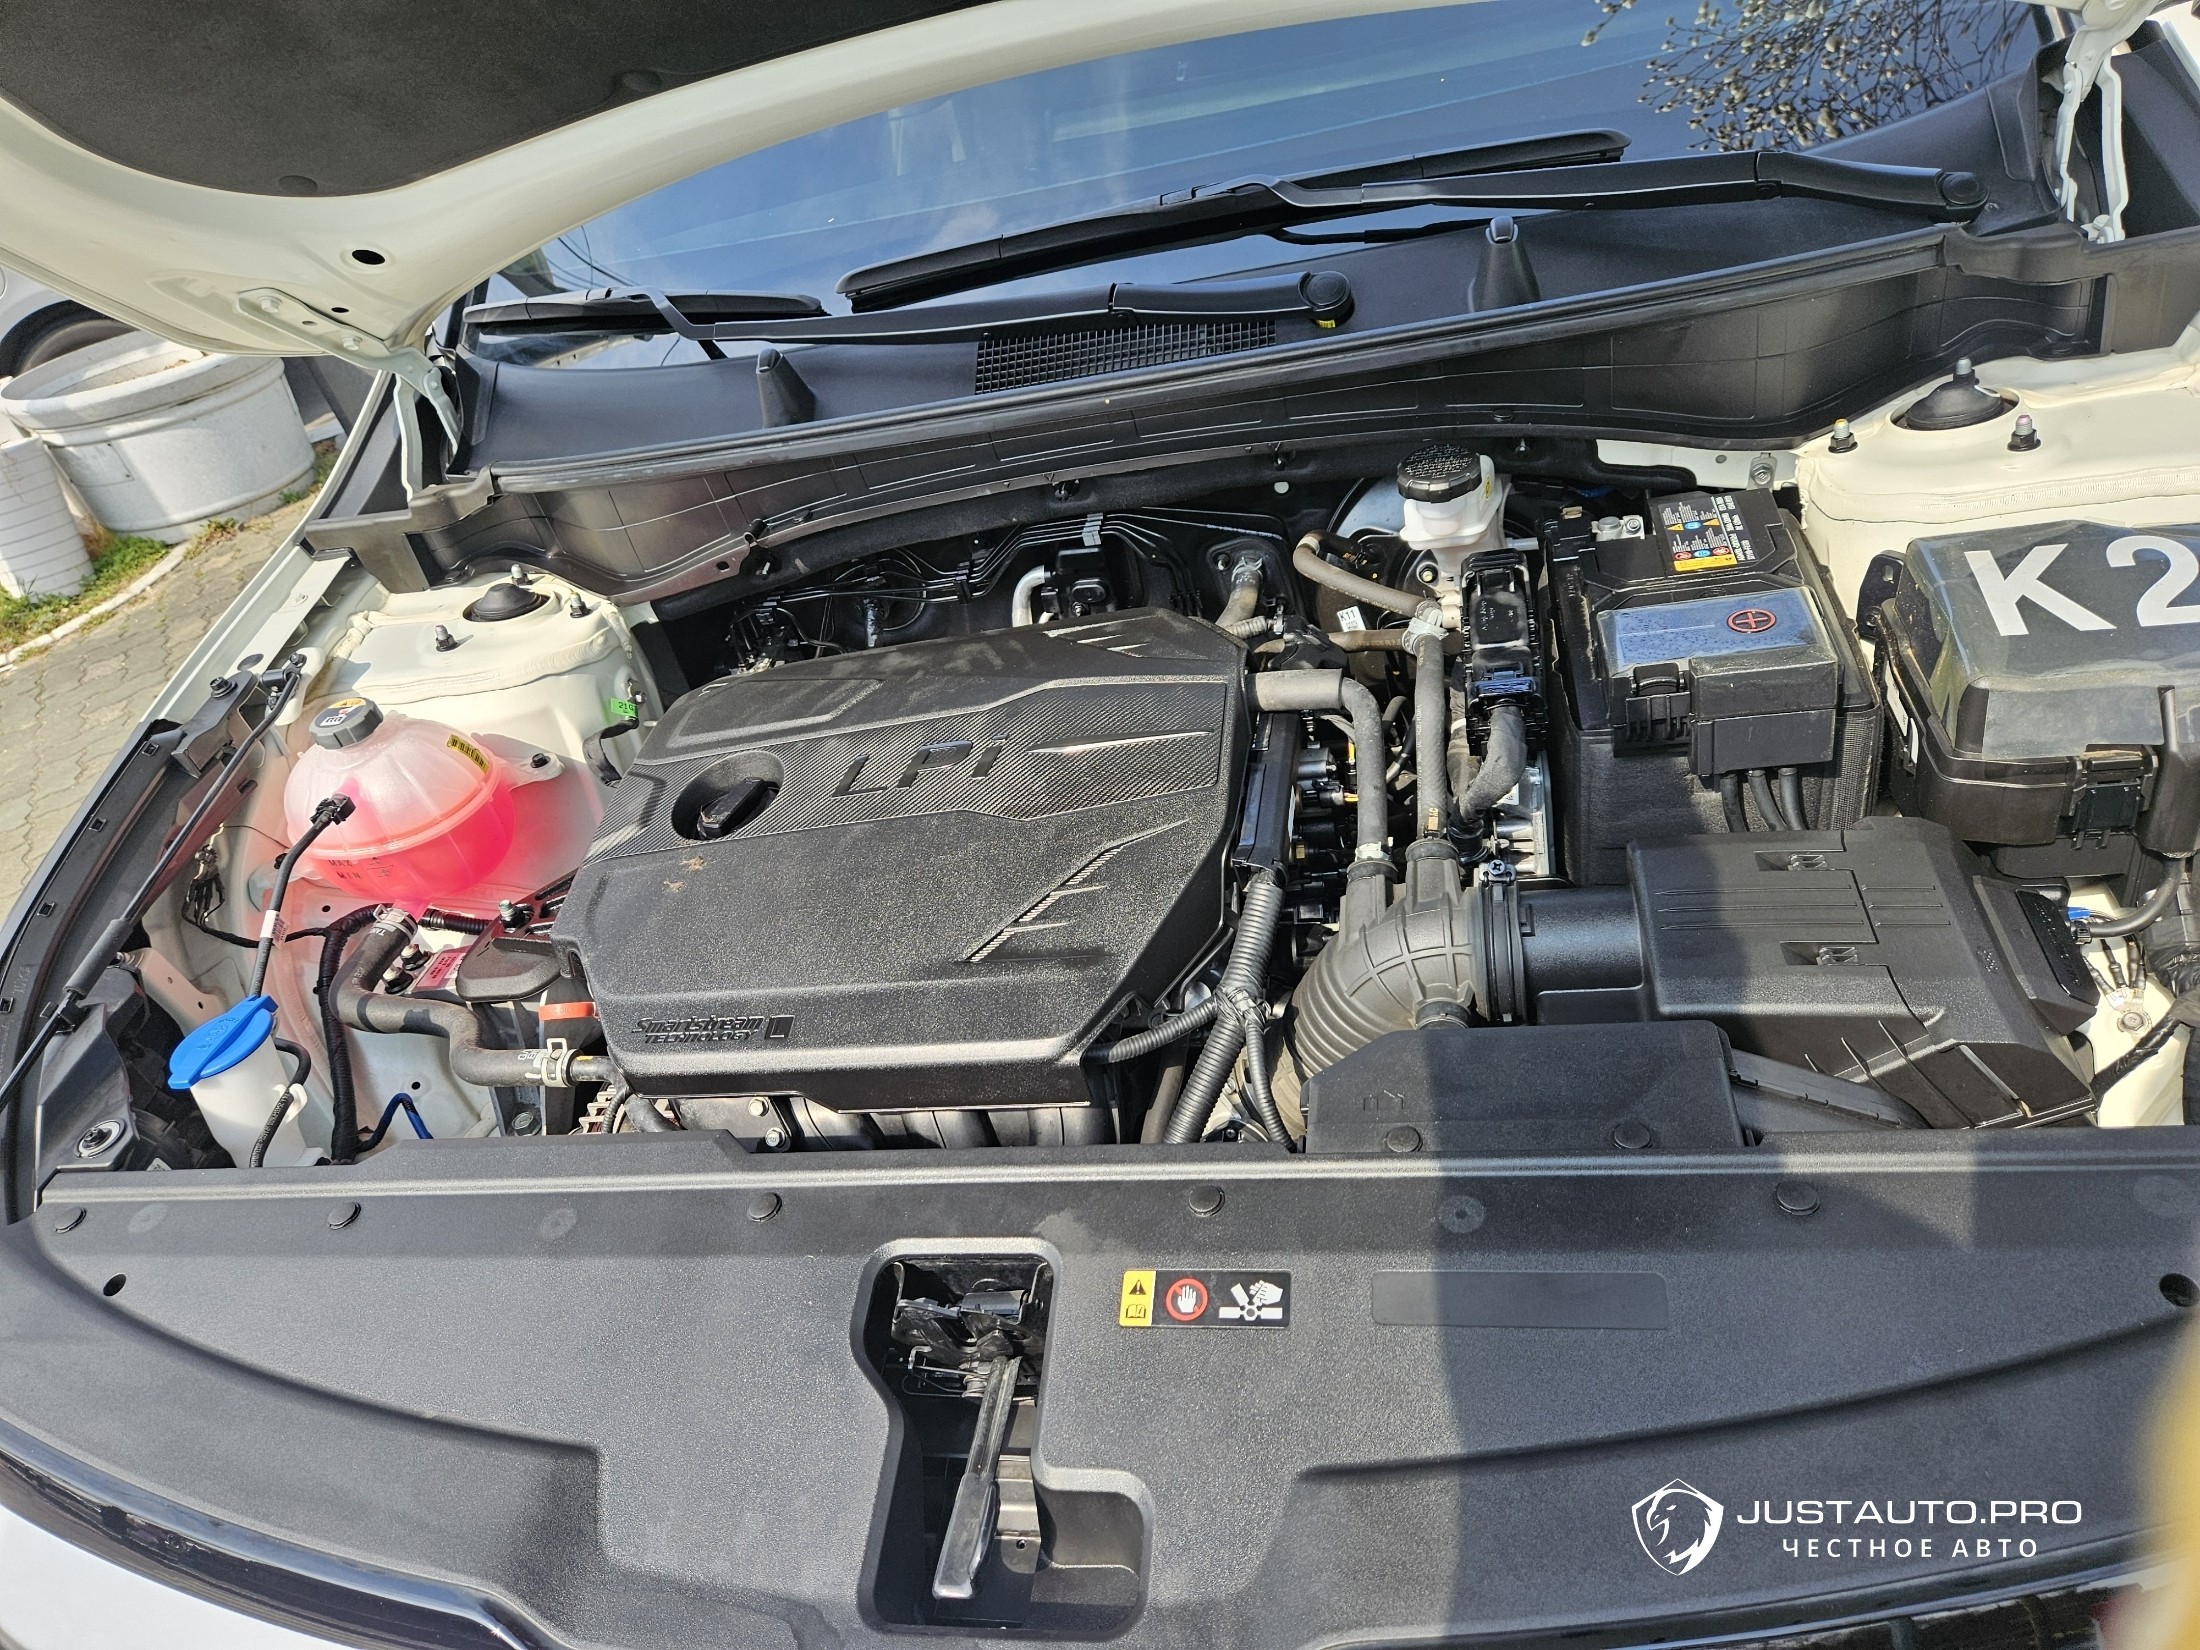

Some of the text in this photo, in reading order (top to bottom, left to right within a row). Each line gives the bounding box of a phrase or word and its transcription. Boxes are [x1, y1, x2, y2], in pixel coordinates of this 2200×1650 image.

[831, 732, 1010, 798] LPi
[328, 859, 353, 867] MAX
[336, 871, 361, 880] MIN
[631, 1014, 765, 1034] Smartstream
[644, 1029, 758, 1044] TECHNOLOGY
